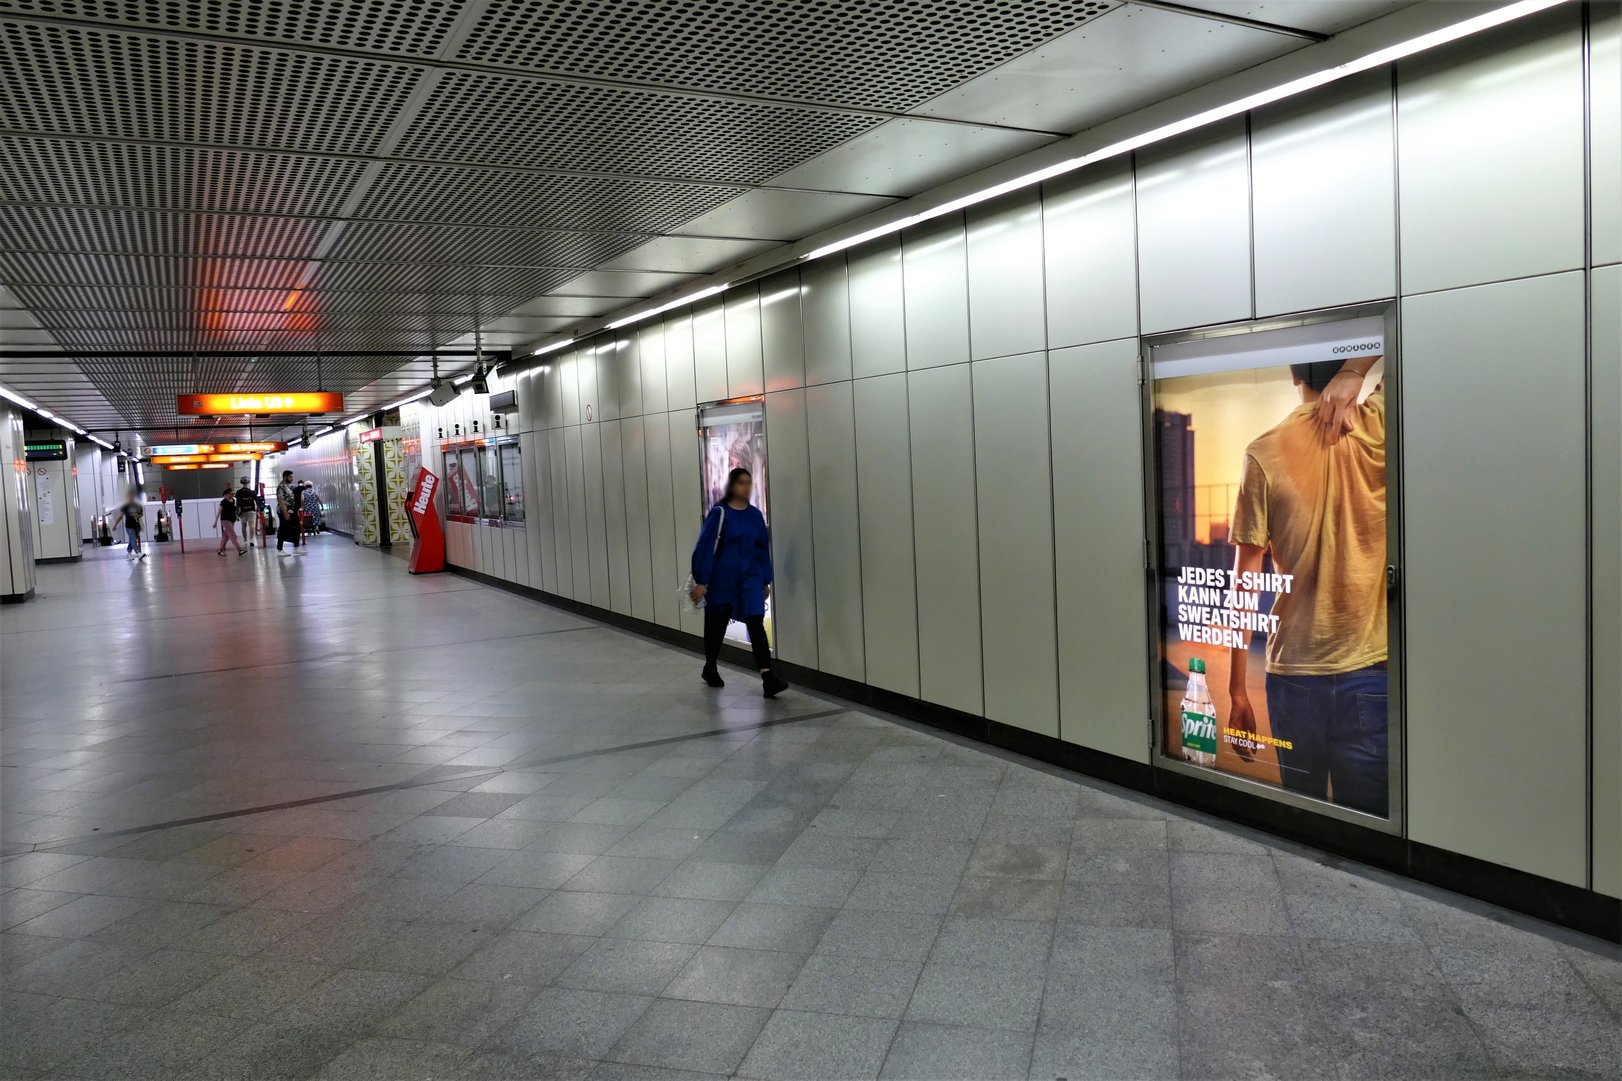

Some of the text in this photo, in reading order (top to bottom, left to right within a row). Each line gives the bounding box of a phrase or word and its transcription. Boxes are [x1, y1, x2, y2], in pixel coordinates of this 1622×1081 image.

[413, 474, 435, 515] Heute
[1177, 566, 1294, 594] JEDES T-SHIRT
[1178, 585, 1259, 611] KANN ZUM
[1178, 604, 1280, 634] SWEATSHIRT
[1178, 623, 1248, 650] WERDEN.
[1223, 727, 1247, 739] HEAT
[1247, 730, 1294, 750] HAPPENS
[1223, 734, 1239, 747] STAY
[1238, 738, 1256, 750] COOL
